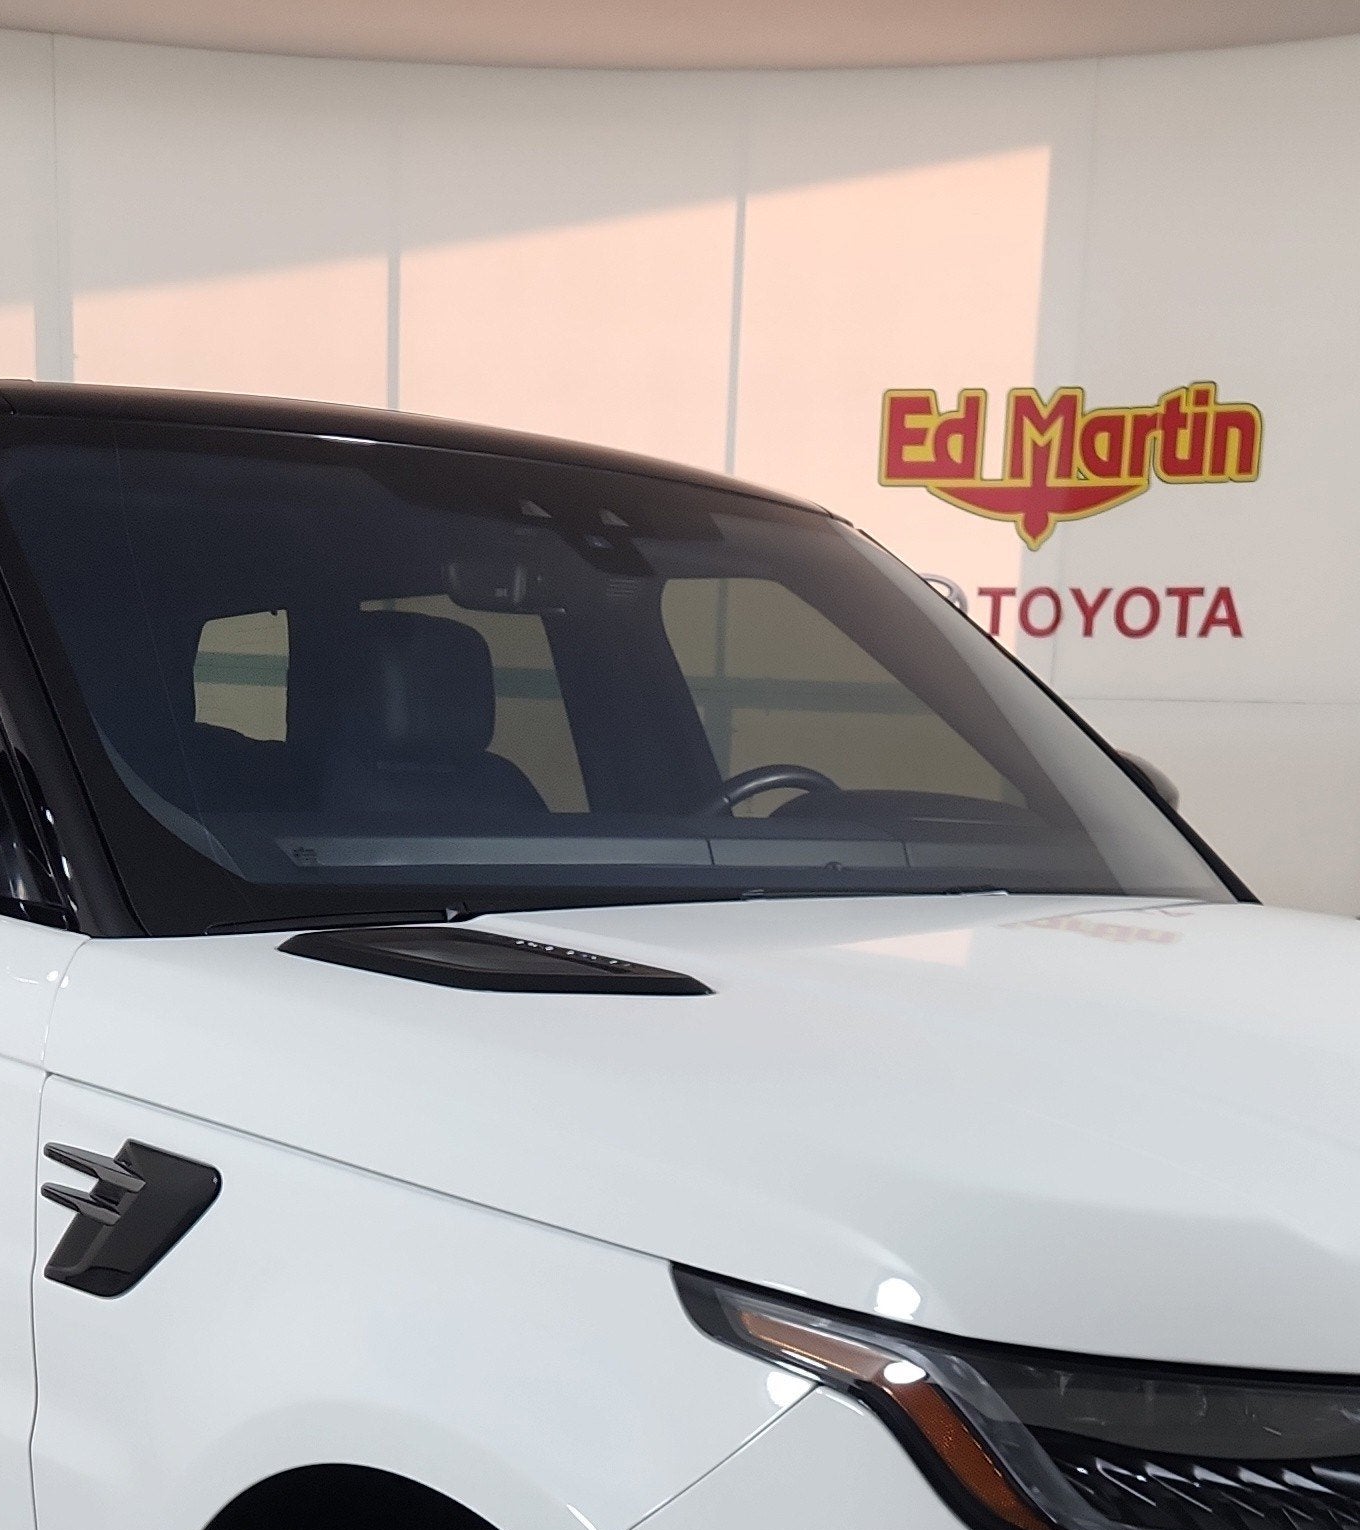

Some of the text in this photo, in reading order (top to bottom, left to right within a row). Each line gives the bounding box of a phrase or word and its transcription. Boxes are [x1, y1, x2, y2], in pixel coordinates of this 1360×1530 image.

[885, 387, 1258, 480] Ed Martin
[976, 584, 1244, 639] TOYOTA
